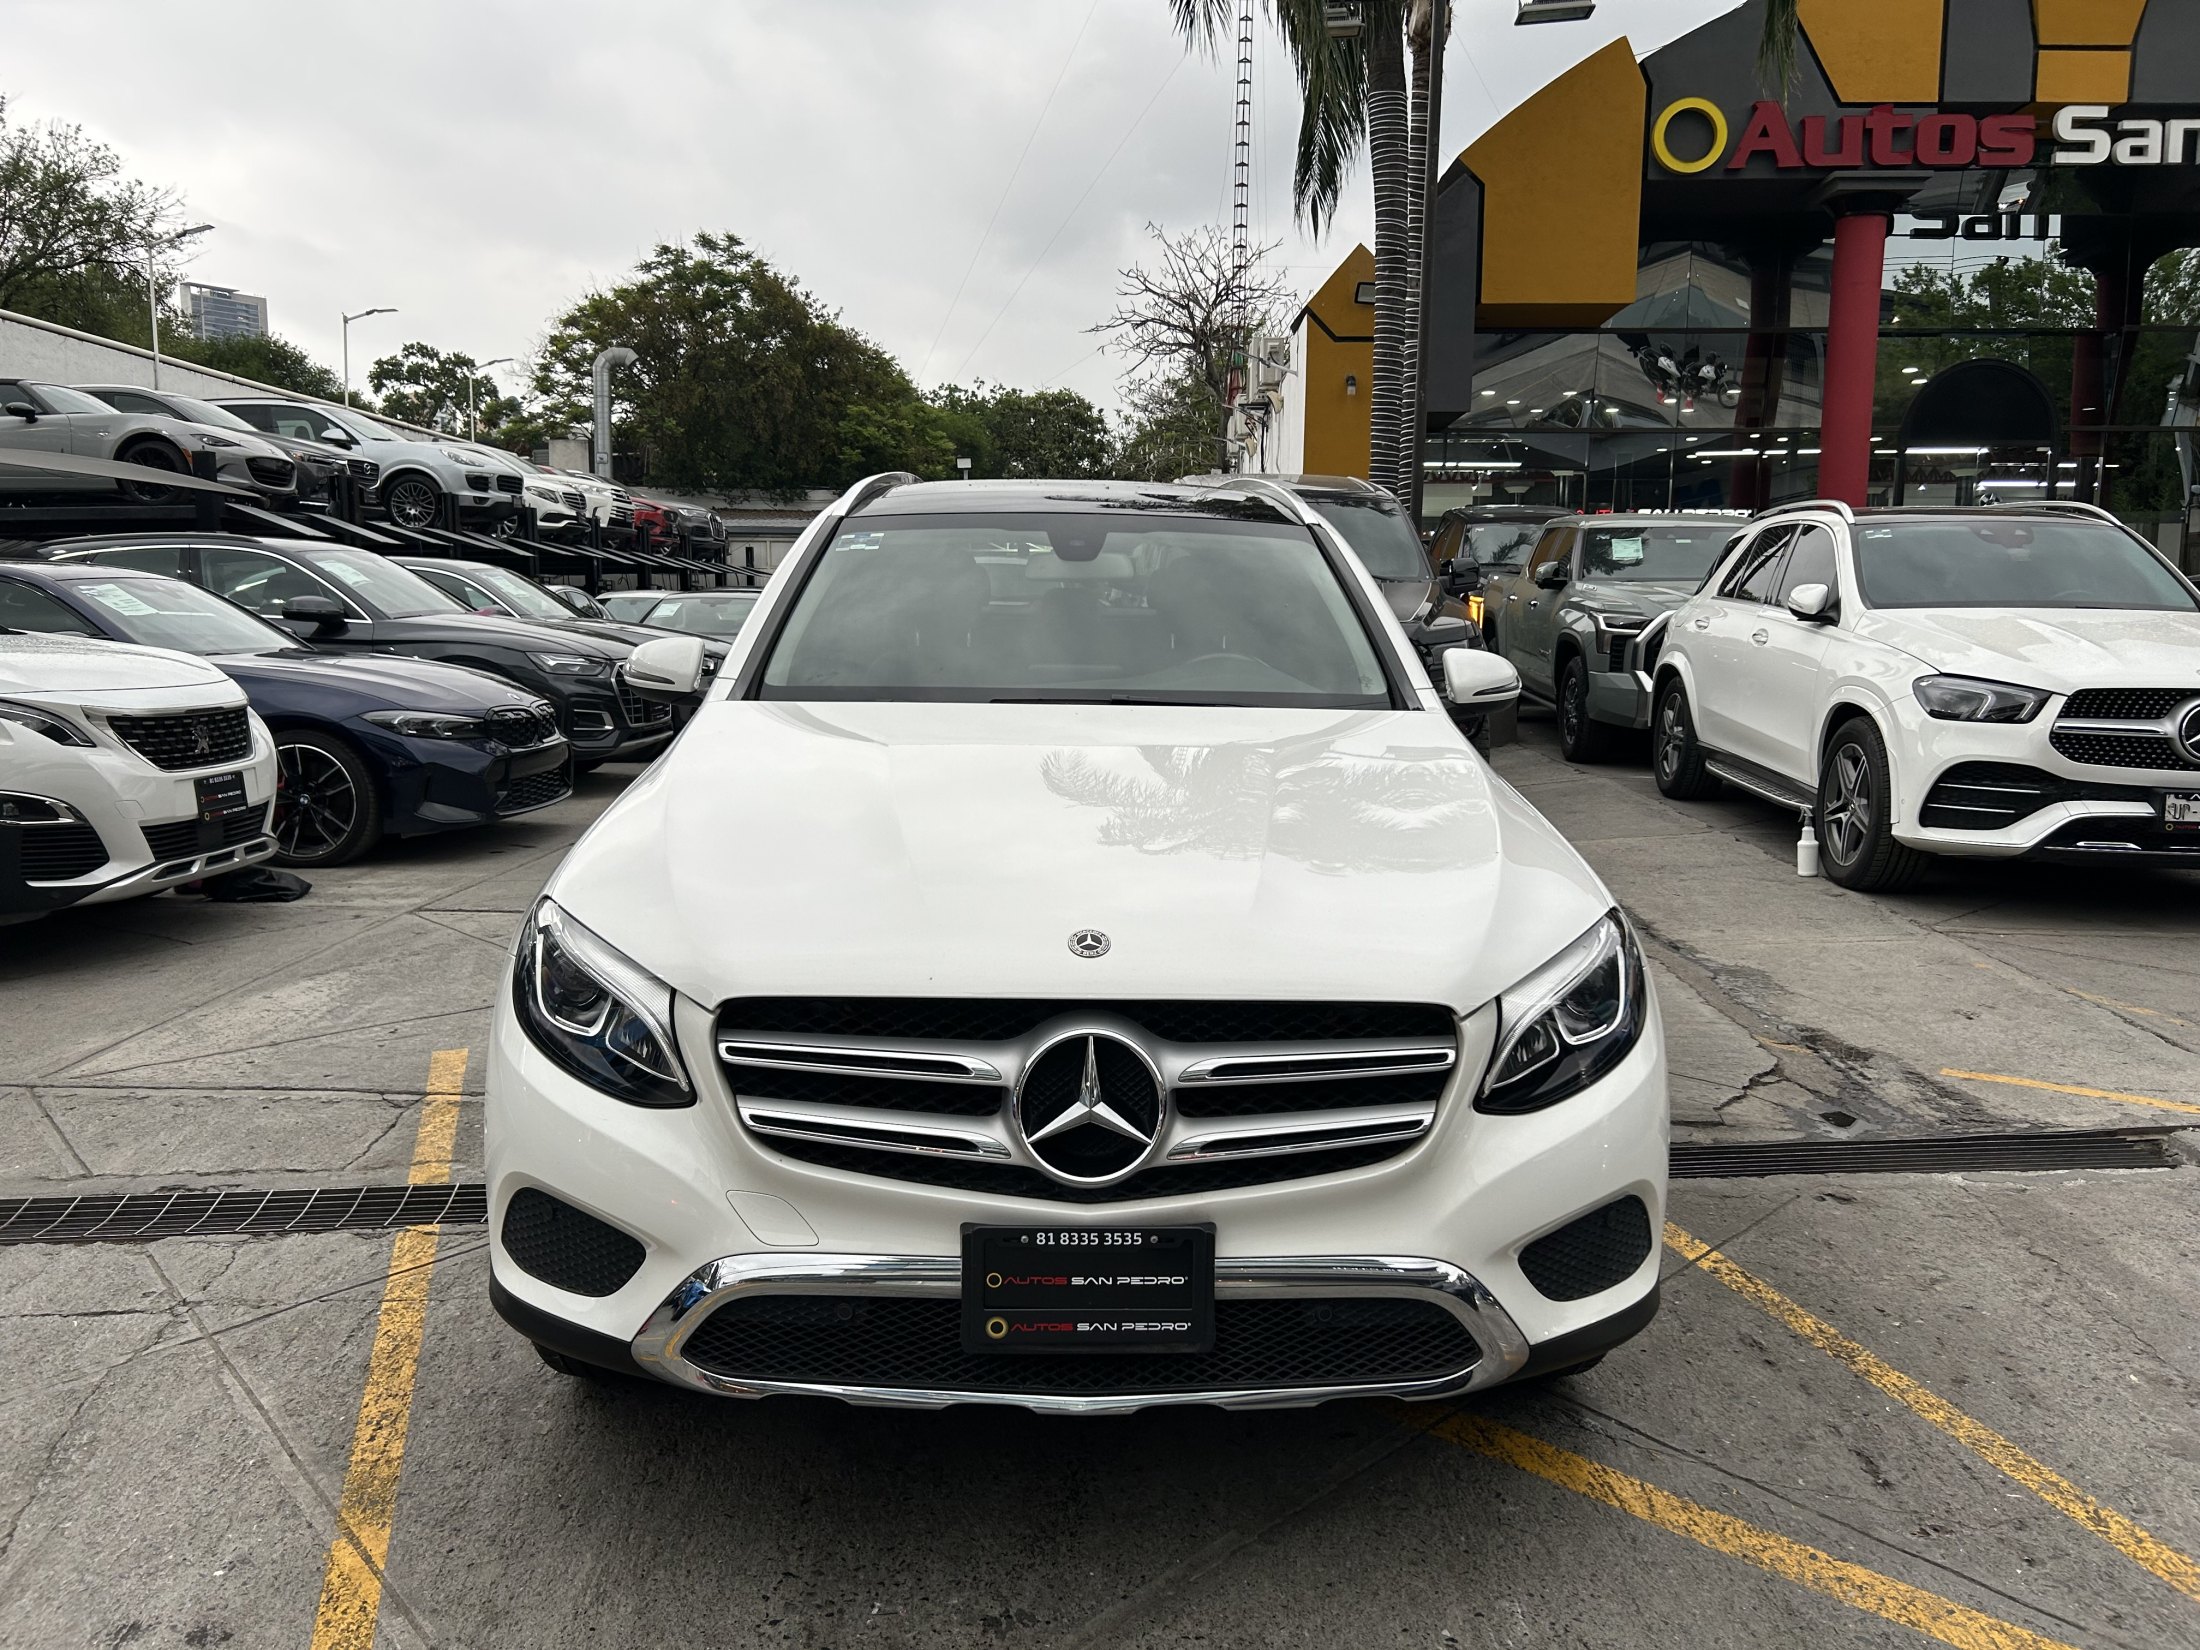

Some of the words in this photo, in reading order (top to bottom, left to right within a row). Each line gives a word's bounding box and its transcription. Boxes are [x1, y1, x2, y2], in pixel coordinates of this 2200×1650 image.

[1726, 101, 2036, 169] Autos
[2050, 105, 2200, 166] San
[1036, 1232, 1055, 1245] 81
[1060, 1232, 1099, 1245] 8335
[1103, 1232, 1142, 1245] 3535
[1003, 1276, 1068, 1285] AUTOS
[1071, 1276, 1112, 1285] SAN
[1116, 1276, 1185, 1285] PEDRO
[1010, 1322, 1073, 1332] AUTOS
[1076, 1322, 1117, 1331] SAN
[1121, 1322, 1186, 1331] PEDRO
